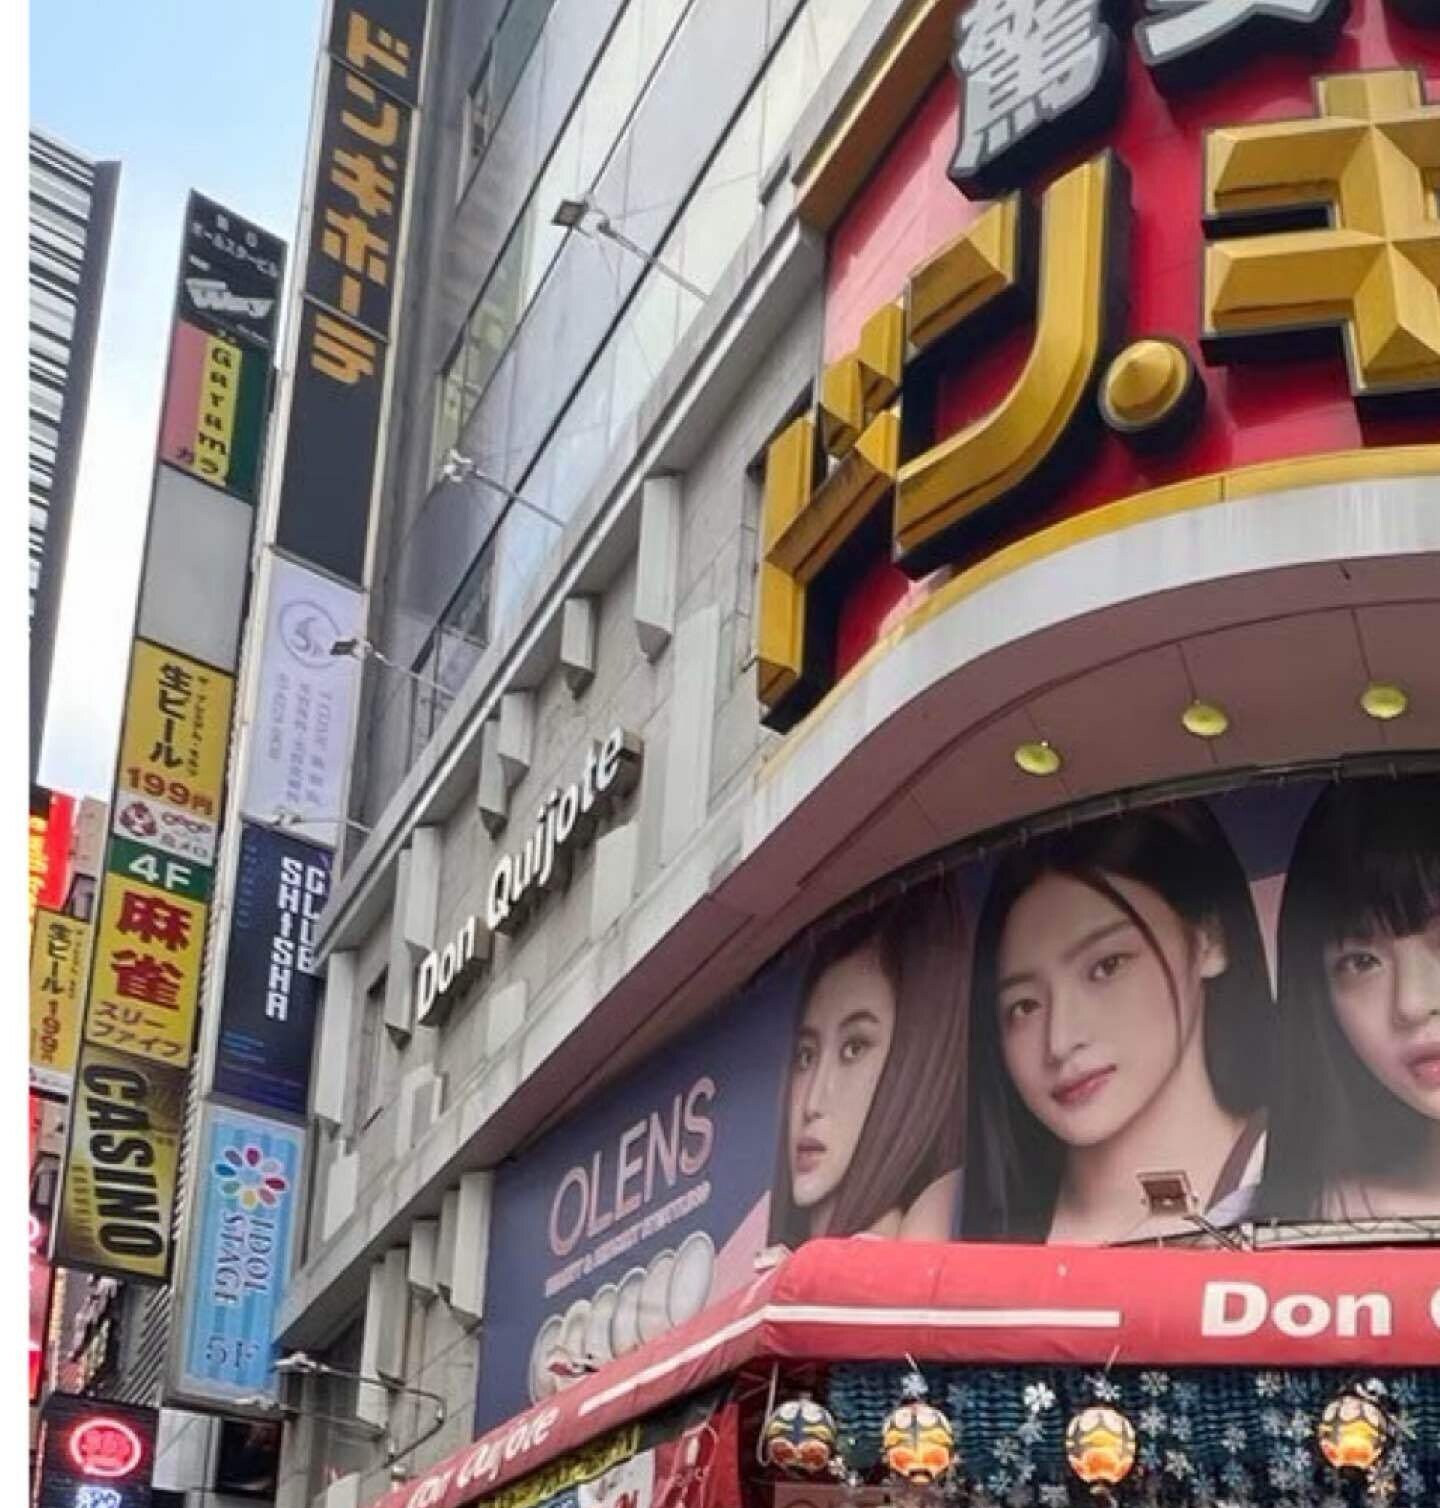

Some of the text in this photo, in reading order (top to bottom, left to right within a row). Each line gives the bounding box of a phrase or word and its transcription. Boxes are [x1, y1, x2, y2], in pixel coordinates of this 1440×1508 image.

[111, 890, 193, 1010] 麻雀
[128, 853, 193, 890] 4F
[265, 856, 304, 1022] SHISHA
[418, 727, 624, 1021] Don Quijote
[83, 1064, 164, 1259] CASINO
[546, 1074, 718, 1258] OLENS
[1201, 1281, 1392, 1337] Don
